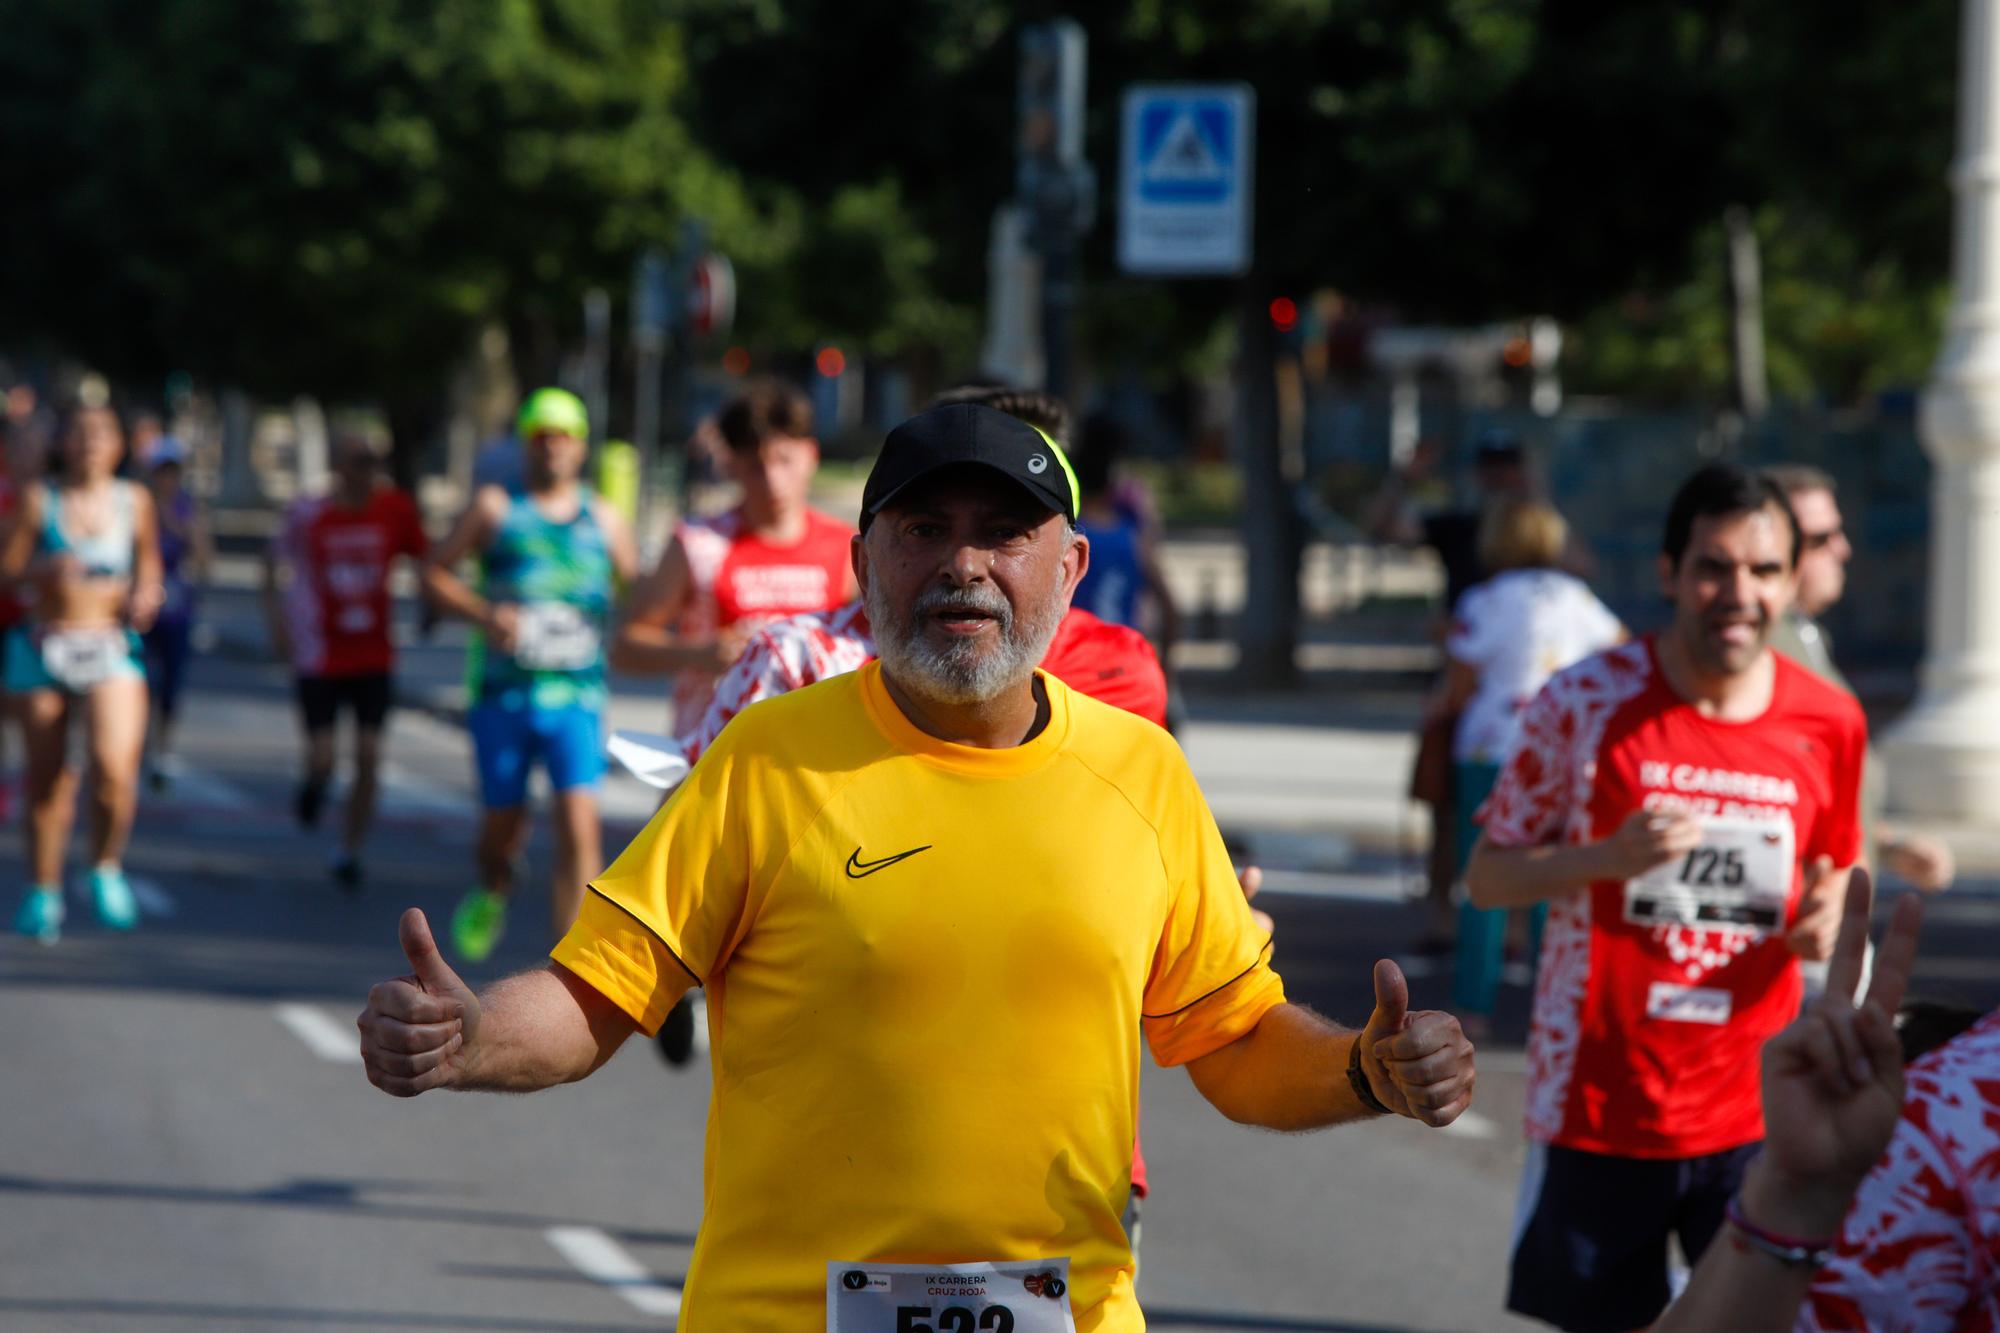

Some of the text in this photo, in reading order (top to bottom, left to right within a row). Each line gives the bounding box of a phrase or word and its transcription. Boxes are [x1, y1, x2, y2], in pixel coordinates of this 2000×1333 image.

[1672, 764, 1798, 803] CARRERA
[925, 1276, 986, 1285] IX CARRERA
[927, 1287, 986, 1296] CRUZ ROJA
